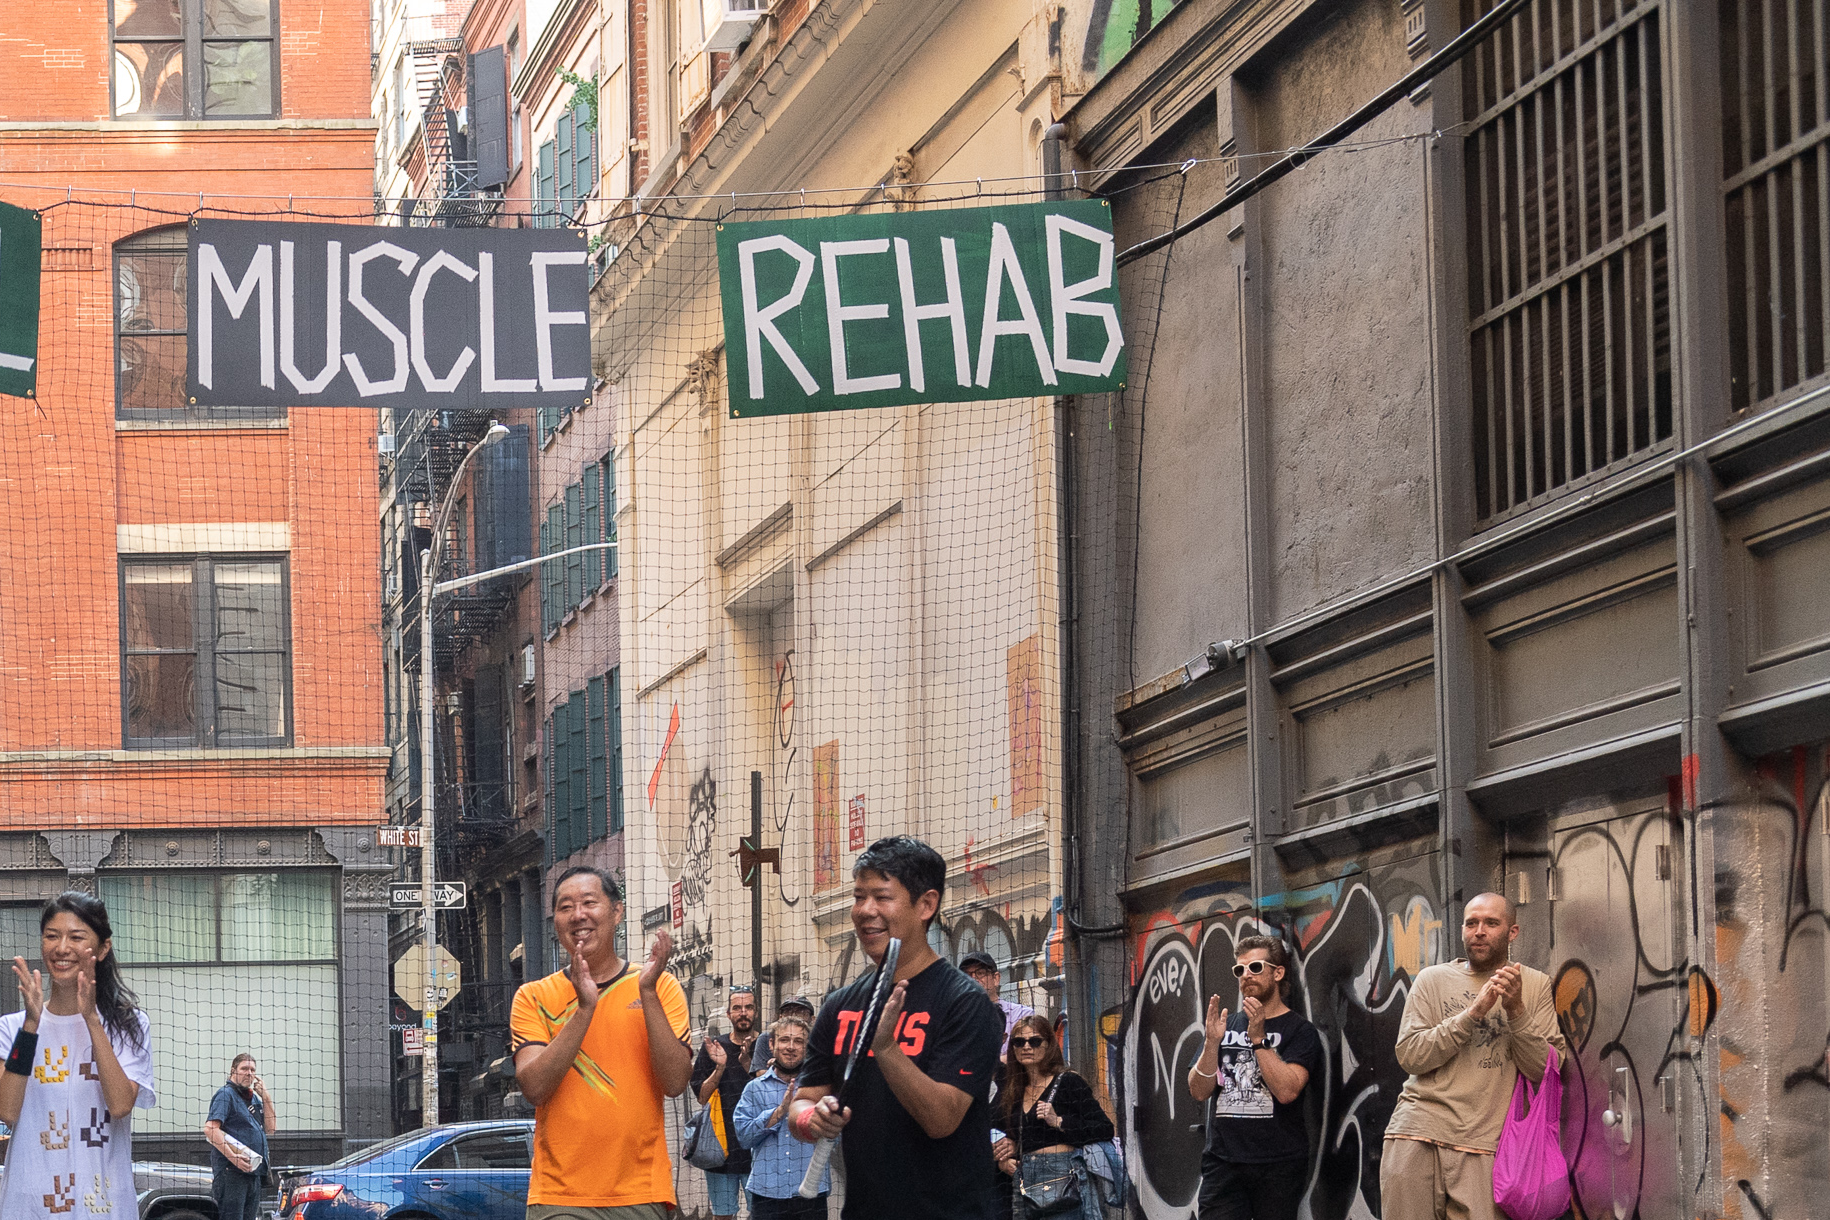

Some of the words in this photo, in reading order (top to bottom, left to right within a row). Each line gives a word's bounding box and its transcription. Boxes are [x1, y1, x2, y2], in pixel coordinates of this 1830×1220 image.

[197, 239, 588, 397] MUSCLE
[737, 214, 1124, 399] REHAB
[379, 829, 406, 846] WHITE
[408, 830, 419, 846] ST
[395, 891, 418, 901] ONE
[1150, 957, 1187, 1004] eve!
